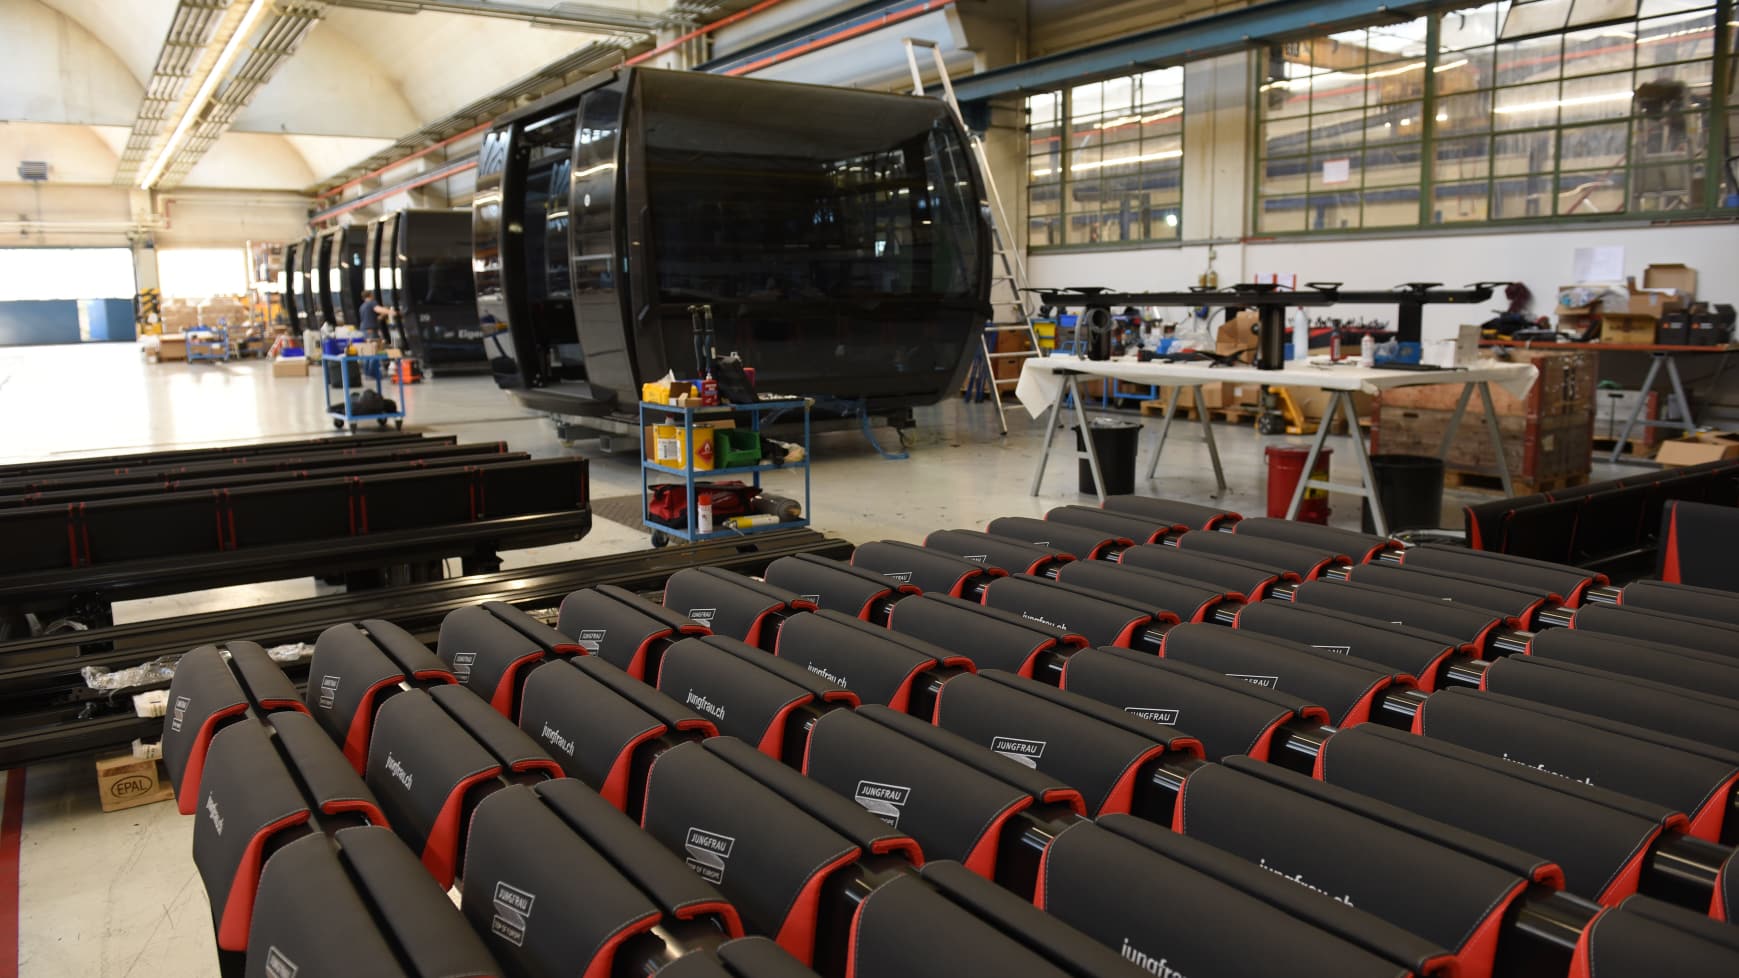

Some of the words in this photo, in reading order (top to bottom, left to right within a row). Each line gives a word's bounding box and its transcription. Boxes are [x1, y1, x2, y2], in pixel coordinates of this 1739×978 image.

[686, 687, 726, 721] jungfrau.ch
[541, 720, 575, 757] jungfrau.ch
[996, 740, 1038, 754] JUNGFRAU
[116, 779, 149, 796] EPAL
[861, 785, 902, 801] JUNGFRAU
[691, 832, 728, 853] JUNGFRAU
[498, 887, 530, 911] JUNGFRAU
